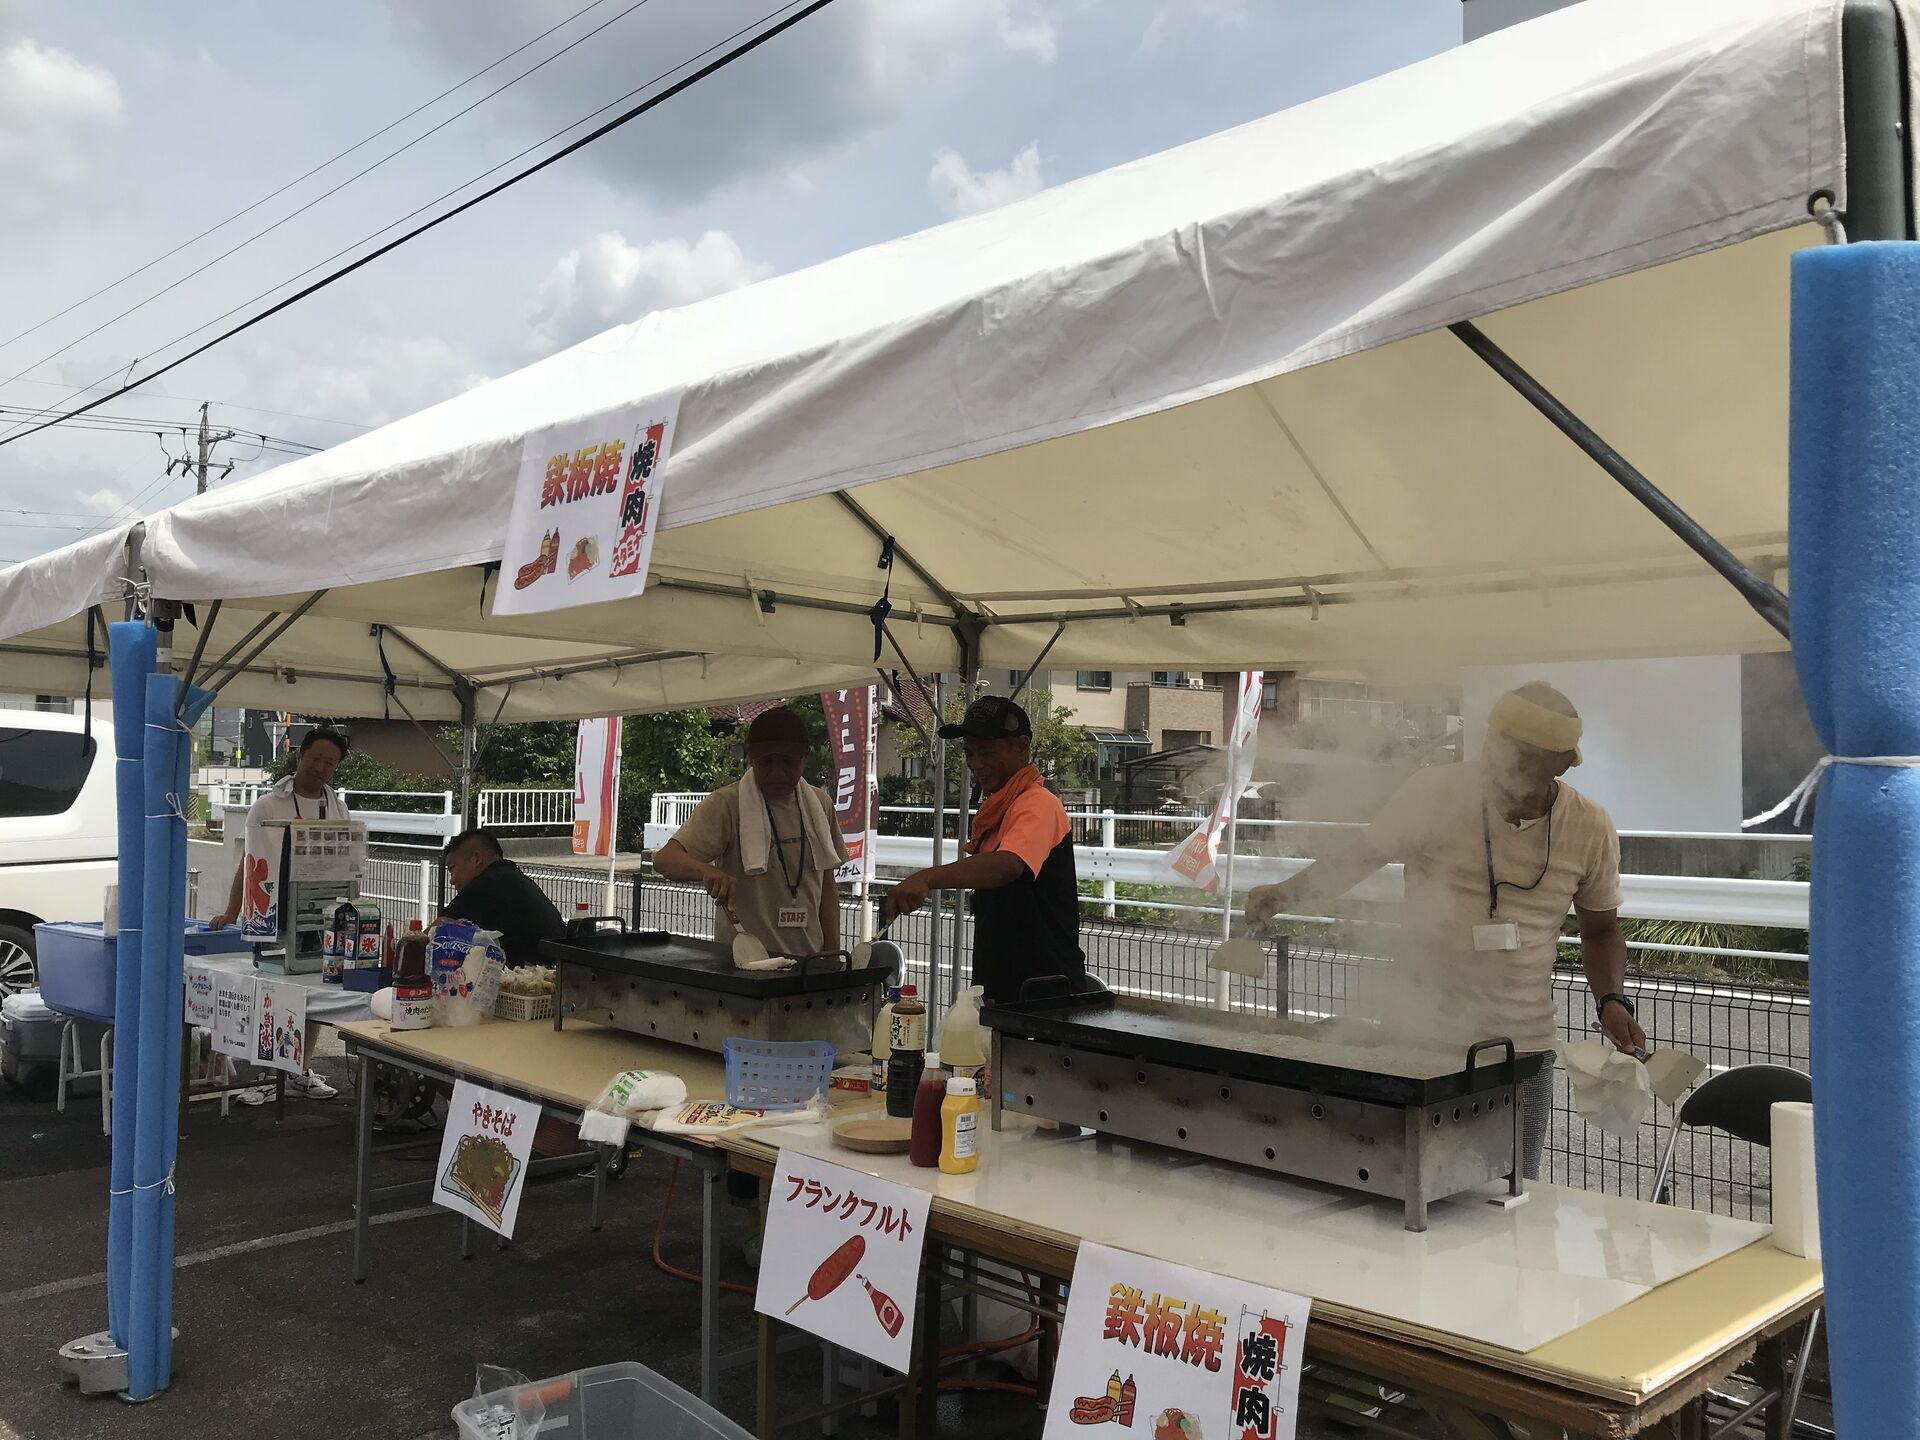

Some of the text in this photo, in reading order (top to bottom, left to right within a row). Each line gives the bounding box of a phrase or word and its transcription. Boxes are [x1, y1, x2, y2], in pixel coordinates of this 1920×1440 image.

[540, 439, 625, 510] 鉄板焼
[621, 440, 655, 528] 焼肉
[361, 935, 377, 953] 氷
[431, 935, 473, 955] Sausa
[780, 911, 806, 923] STAFF
[262, 993, 272, 1050] かき氷
[472, 1101, 516, 1136] やきそば
[786, 1175, 912, 1241] フランクフルト
[1103, 1282, 1227, 1373] 鉄板焼
[1236, 1331, 1278, 1434] 焼肉
